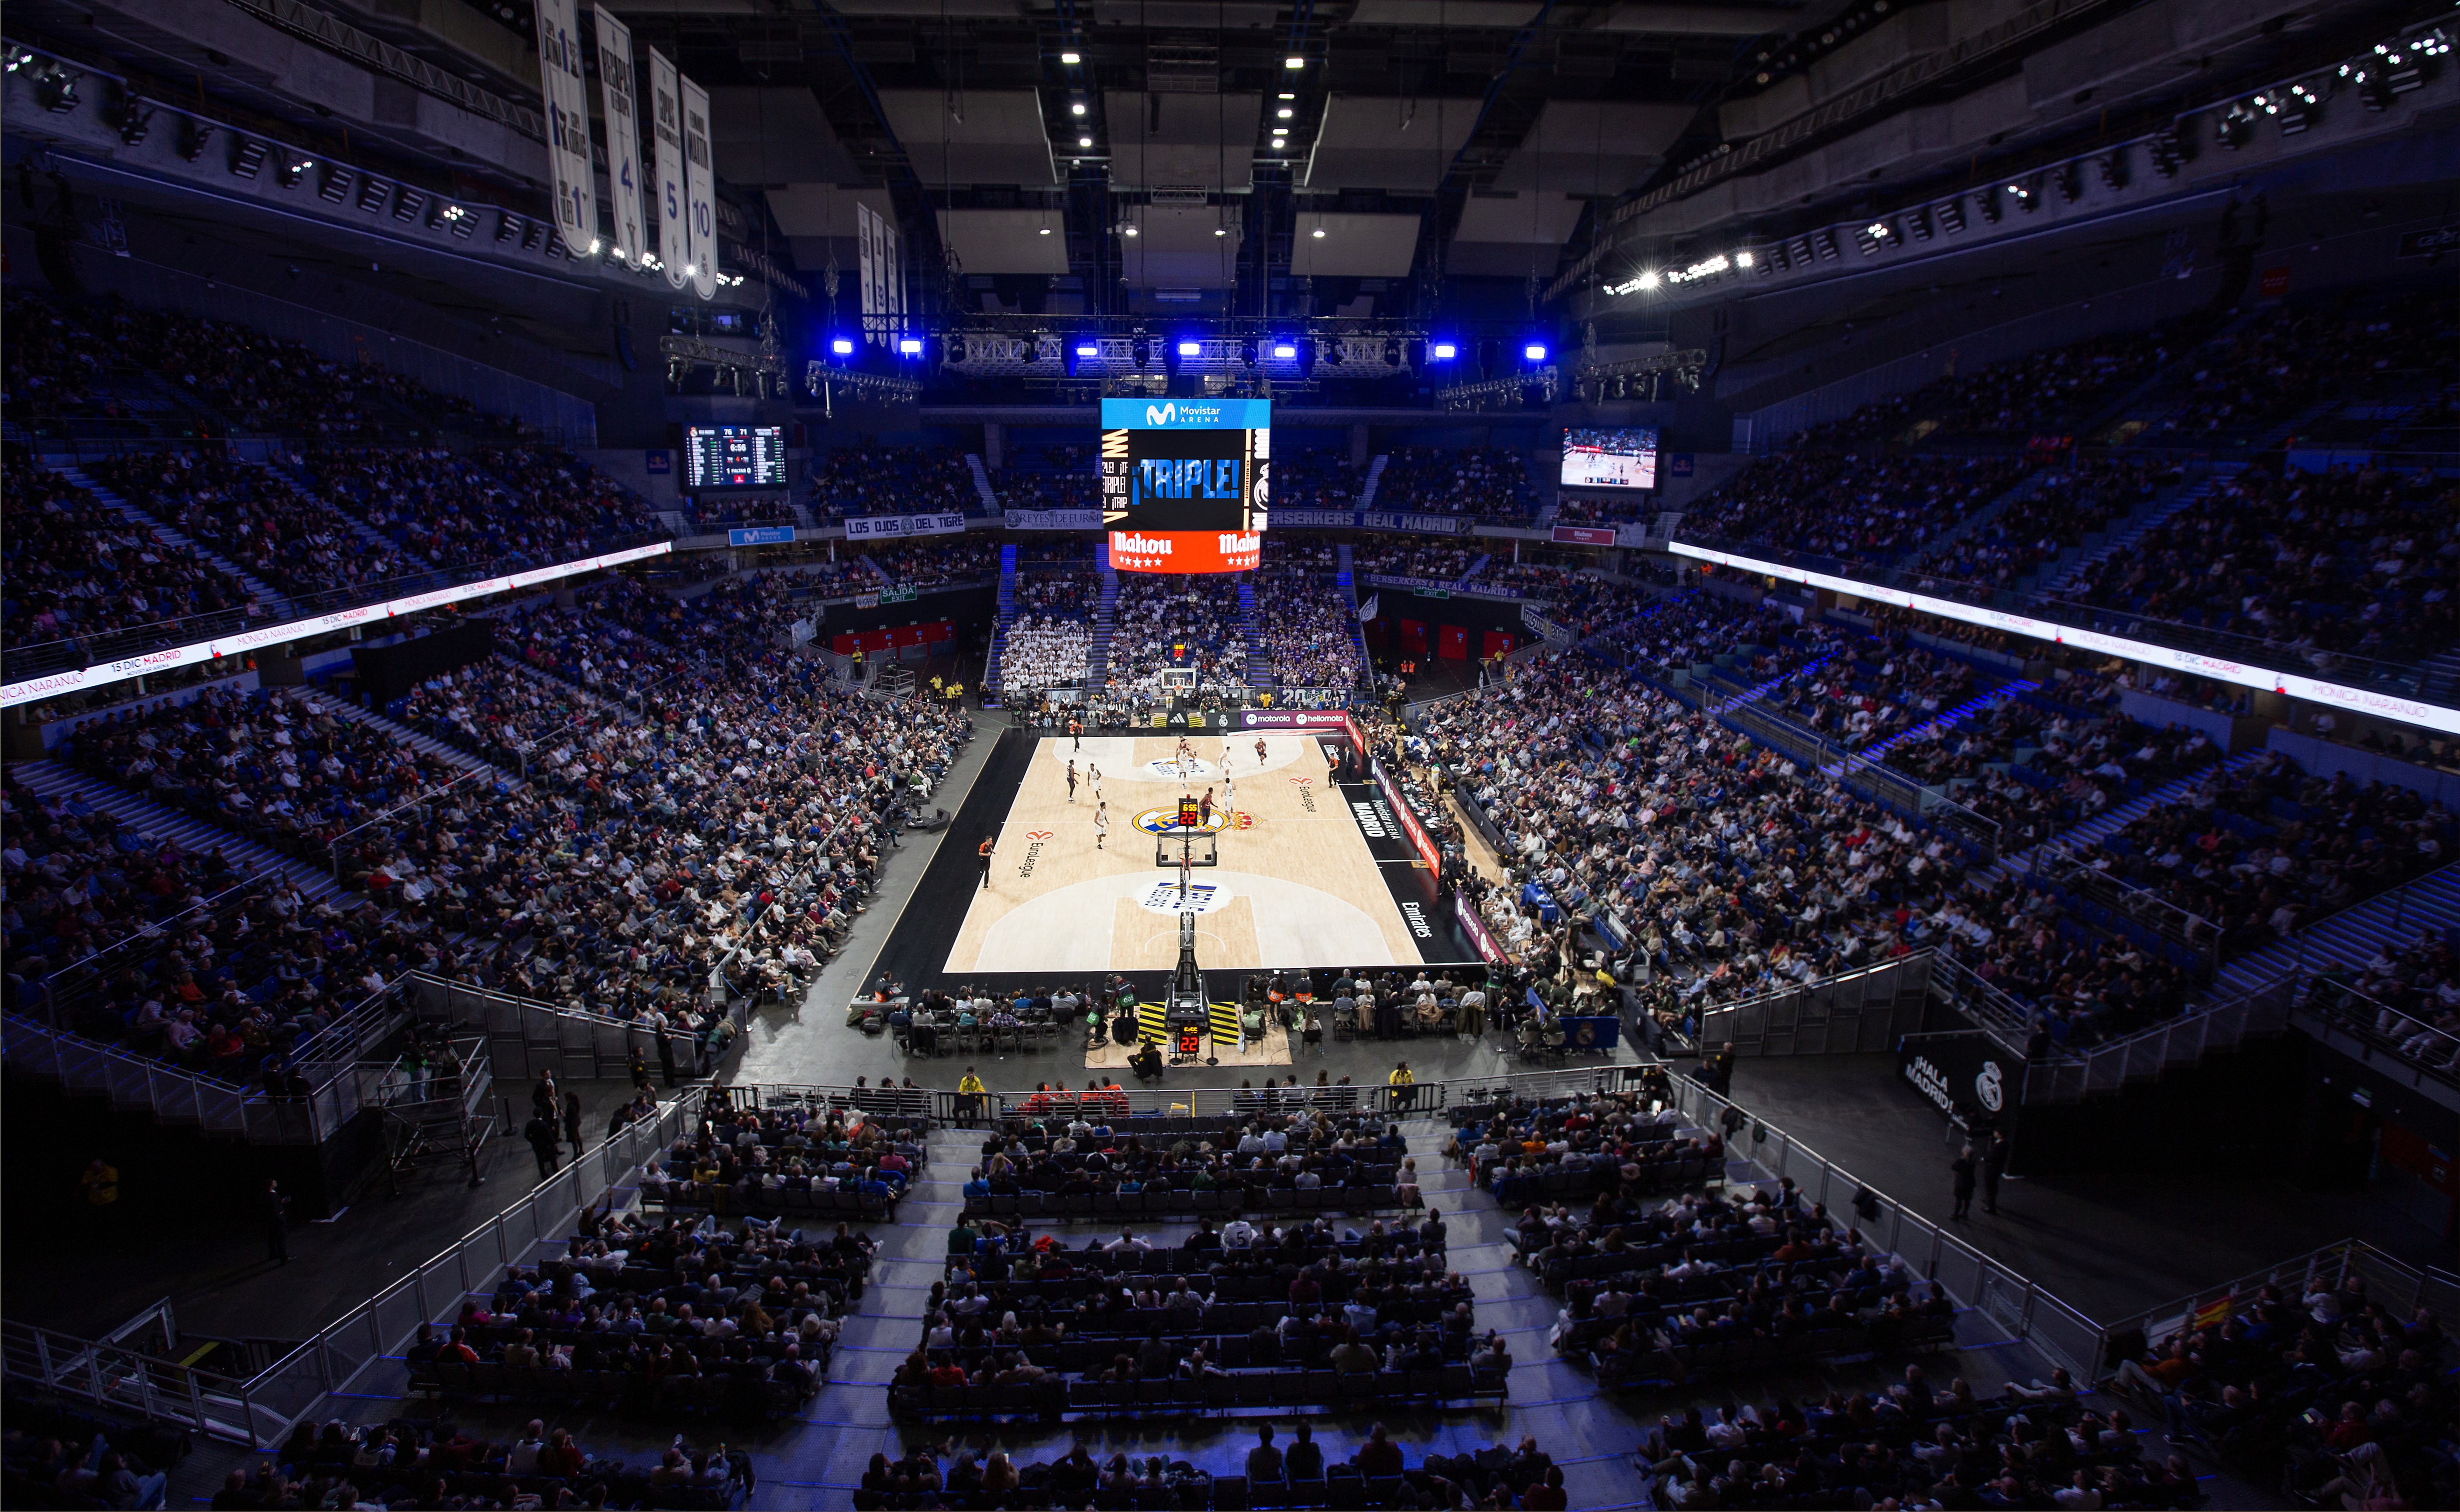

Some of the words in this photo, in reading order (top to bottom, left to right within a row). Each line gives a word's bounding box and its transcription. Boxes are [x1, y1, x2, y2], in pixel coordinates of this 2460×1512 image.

[620, 156, 633, 196] 4
[667, 180, 677, 219] 5
[694, 201, 709, 237] 10
[1180, 406, 1221, 415] Movistar
[1132, 459, 1240, 505] ¡TRIPLE!
[849, 522, 869, 534] LOS
[874, 520, 899, 532] OJOS
[915, 518, 934, 529] DEL
[938, 515, 963, 528] TIGRE
[1020, 514, 1049, 523] REYES
[1055, 514, 1067, 523] DE
[1268, 512, 1355, 525] ERSERKERS
[1363, 513, 1397, 529] REAL
[1401, 515, 1457, 533] MADRID
[1115, 532, 1173, 555] Mahou
[882, 587, 914, 597] SALIDA
[1370, 574, 1428, 586] BERSERKERS
[1438, 581, 1464, 591] REAL
[1470, 584, 1508, 597] MADRID
[1876, 588, 1895, 597] MADRID
[271, 623, 305, 639] NARANJO
[343, 608, 368, 619] MADRID
[1996, 613, 2007, 622] DIC
[2009, 616, 2034, 628] MADRID
[2112, 640, 2151, 656] NARANJO
[2174, 652, 2182, 661] 15
[2184, 654, 2201, 665] DIC
[2203, 659, 2242, 674] MADRID
[1, 686, 26, 698] NICA
[28, 672, 84, 694] NARANJO
[111, 663, 122, 673] 15
[124, 658, 141, 670] DIC
[144, 650, 181, 666] MADRID
[127, 667, 152, 677] MOVISTAR
[2363, 693, 2429, 718] NARANJO
[1307, 715, 1344, 723] hellomoto
[1183, 804, 1197, 812] 6:55
[1299, 786, 1316, 813] EuroLeague
[1180, 812, 1196, 825] 22
[1352, 802, 1386, 837] MADRID
[1372, 800, 1392, 821] Movistar
[1383, 821, 1401, 840] ARENA
[1404, 812, 1417, 836] motorola
[1421, 838, 1438, 869] hellomoto
[1018, 842, 1043, 878] EuroLeague
[1402, 902, 1432, 938] Emirates
[1462, 910, 1479, 937] motorola
[1180, 1037, 1198, 1052] 22
[1904, 1063, 1954, 1114] MADRID!
